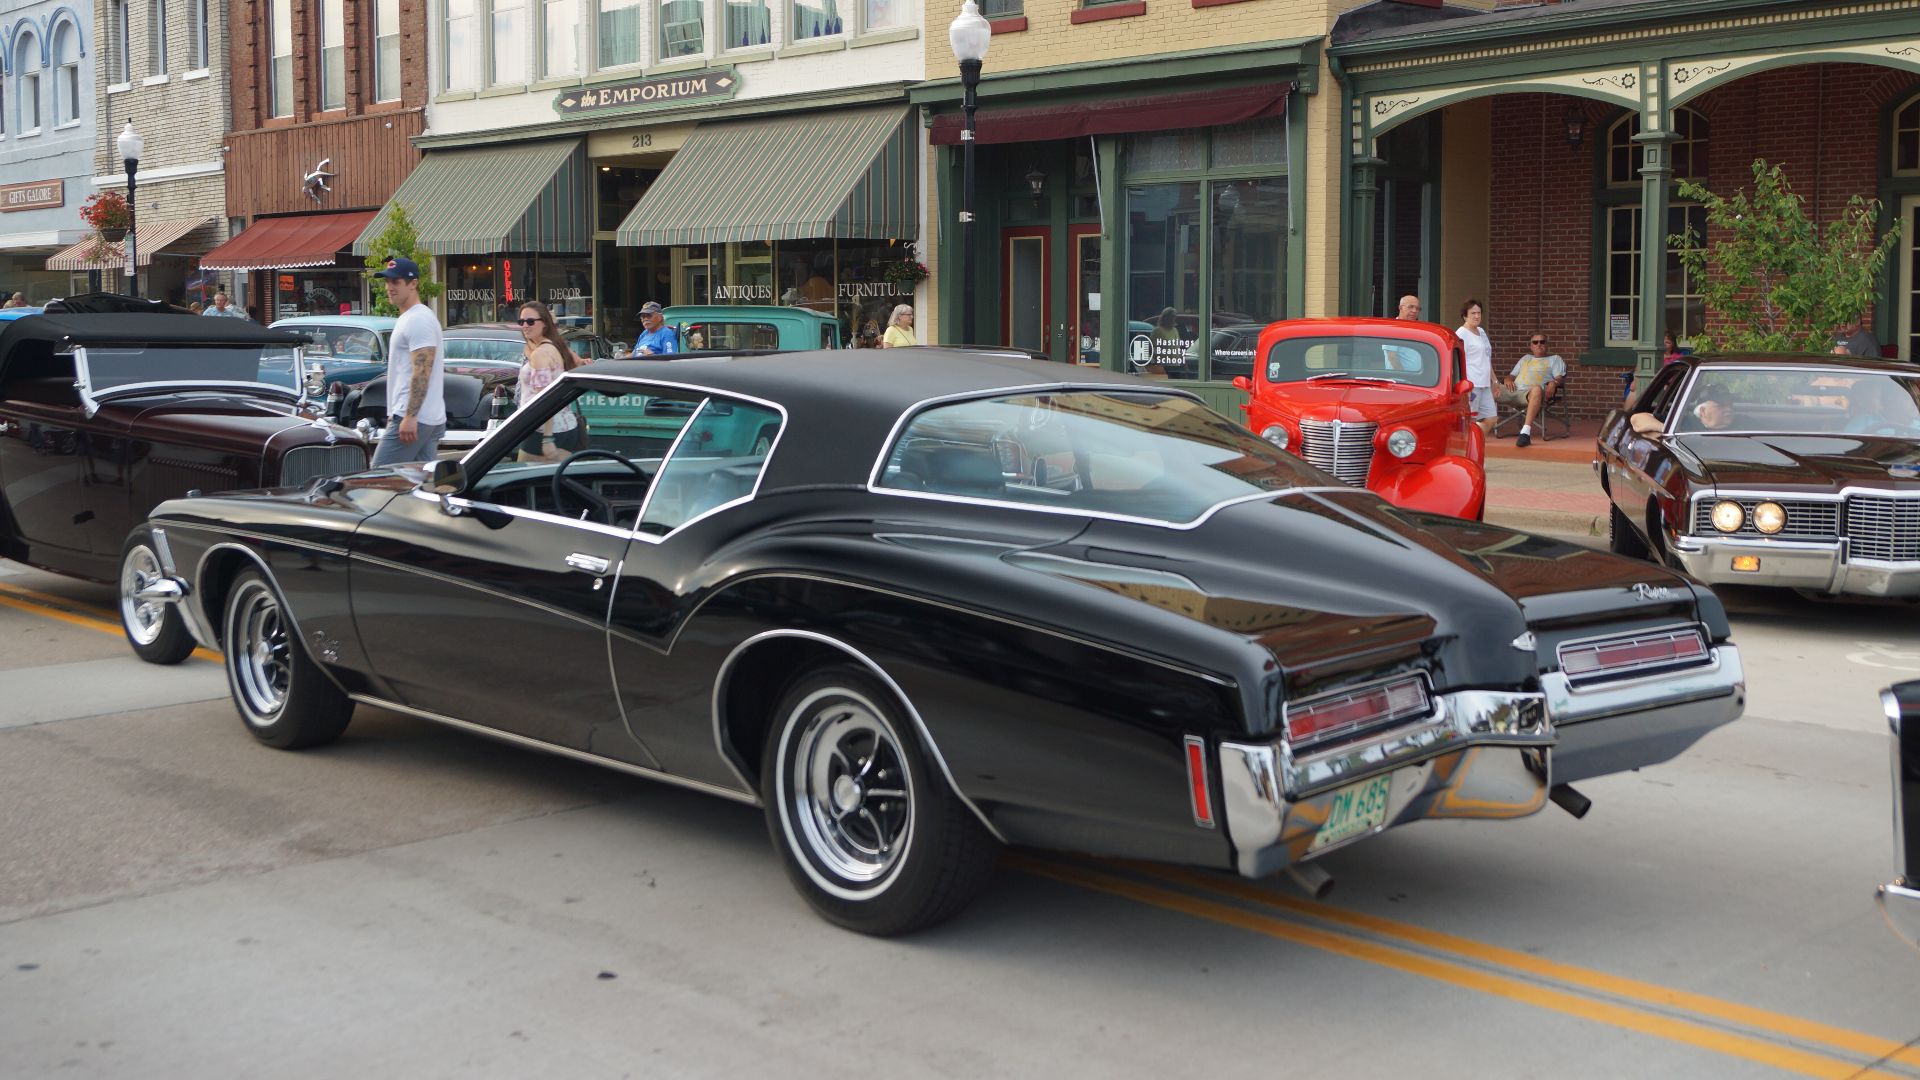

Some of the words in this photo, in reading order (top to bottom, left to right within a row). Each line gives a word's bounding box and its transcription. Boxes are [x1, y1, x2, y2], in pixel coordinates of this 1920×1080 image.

[580, 90, 597, 108] the
[599, 78, 708, 107] EMPORIUM
[632, 134, 652, 149] 213
[9, 190, 26, 204] GIFTS
[27, 187, 52, 202] GALORE
[447, 289, 468, 301] USED
[468, 288, 495, 301] BOOKS
[549, 287, 581, 300] DECOR
[714, 284, 772, 300] ANTIQUES
[838, 282, 914, 297] FURNITU
[1156, 338, 1195, 348] Hastings
[1156, 347, 1187, 356] Beauty
[1156, 355, 1186, 365] School
[1355, 775, 1392, 818] 685
